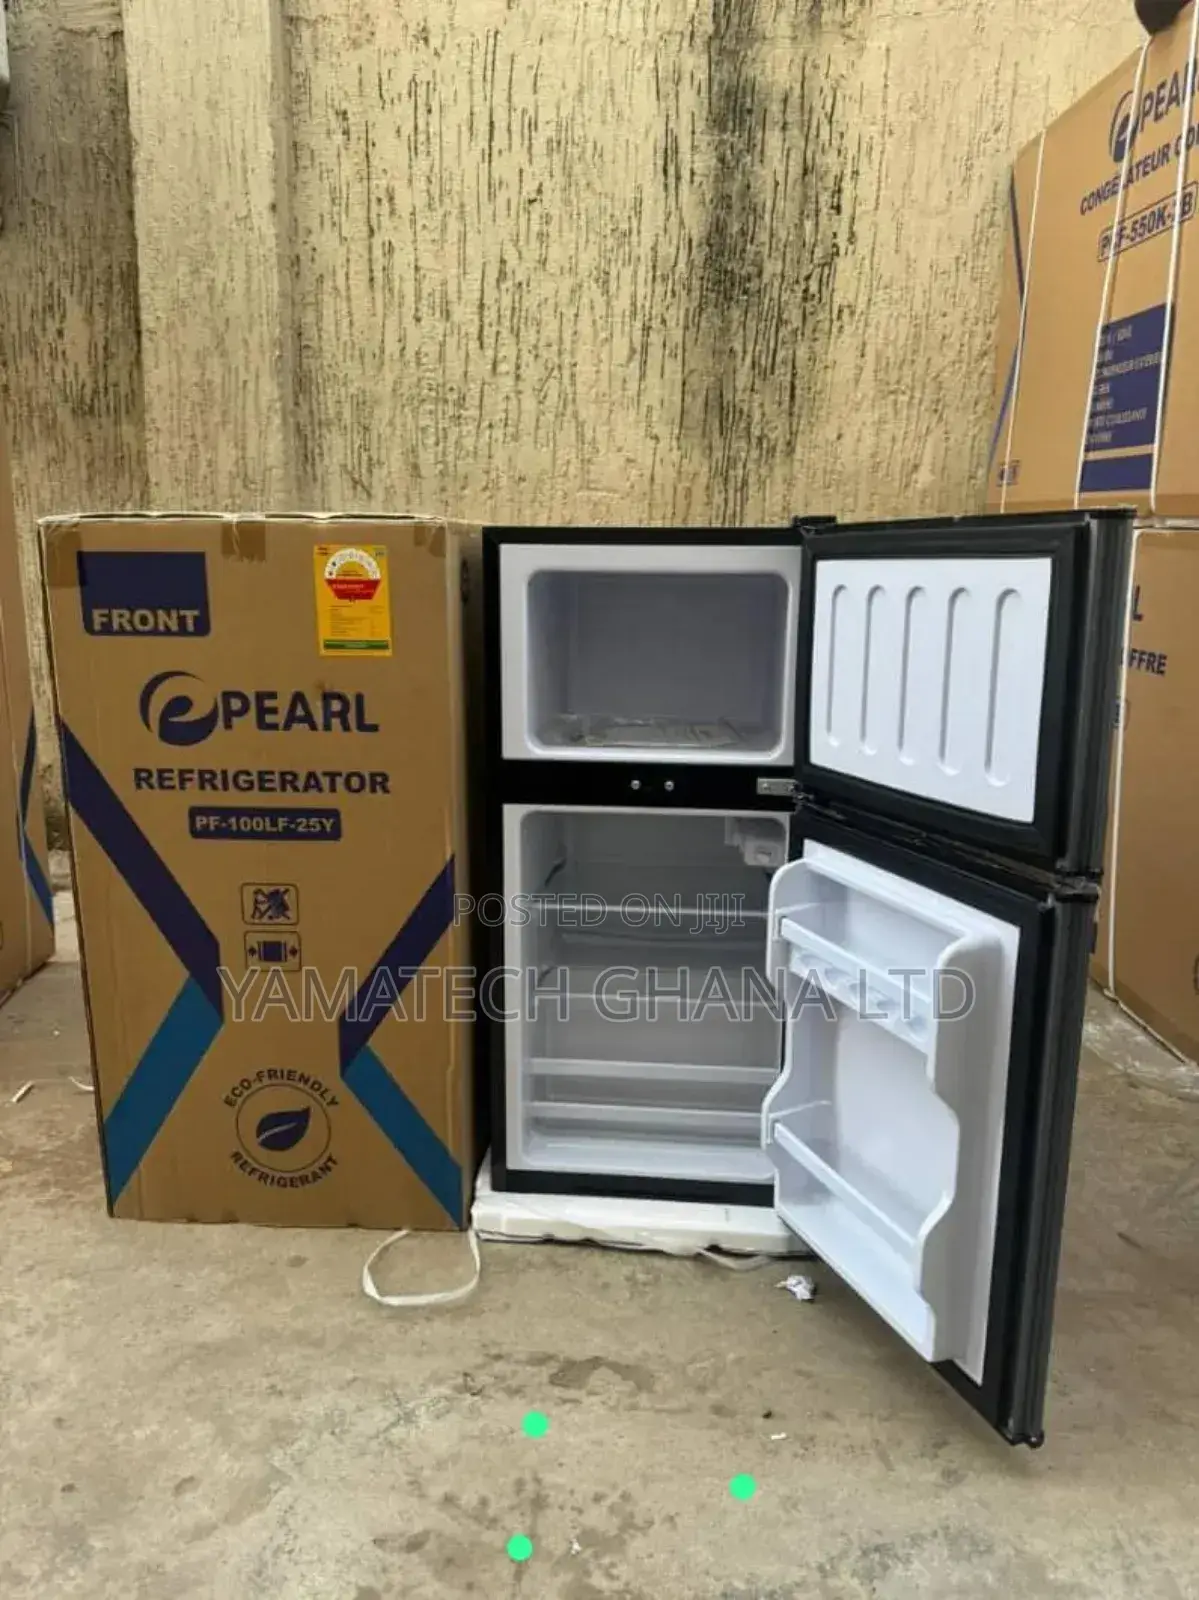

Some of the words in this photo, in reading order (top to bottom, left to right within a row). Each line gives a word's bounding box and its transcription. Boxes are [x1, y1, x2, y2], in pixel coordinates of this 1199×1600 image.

[91, 608, 199, 633] FRONT
[220, 690, 380, 733] PEARL
[134, 768, 390, 794] REFRIGERATOR
[195, 816, 336, 834] PF-100LF-25Y
[223, 1068, 340, 1108] ECO-FRIENDLY
[230, 1150, 339, 1189] REFRIGERANT
